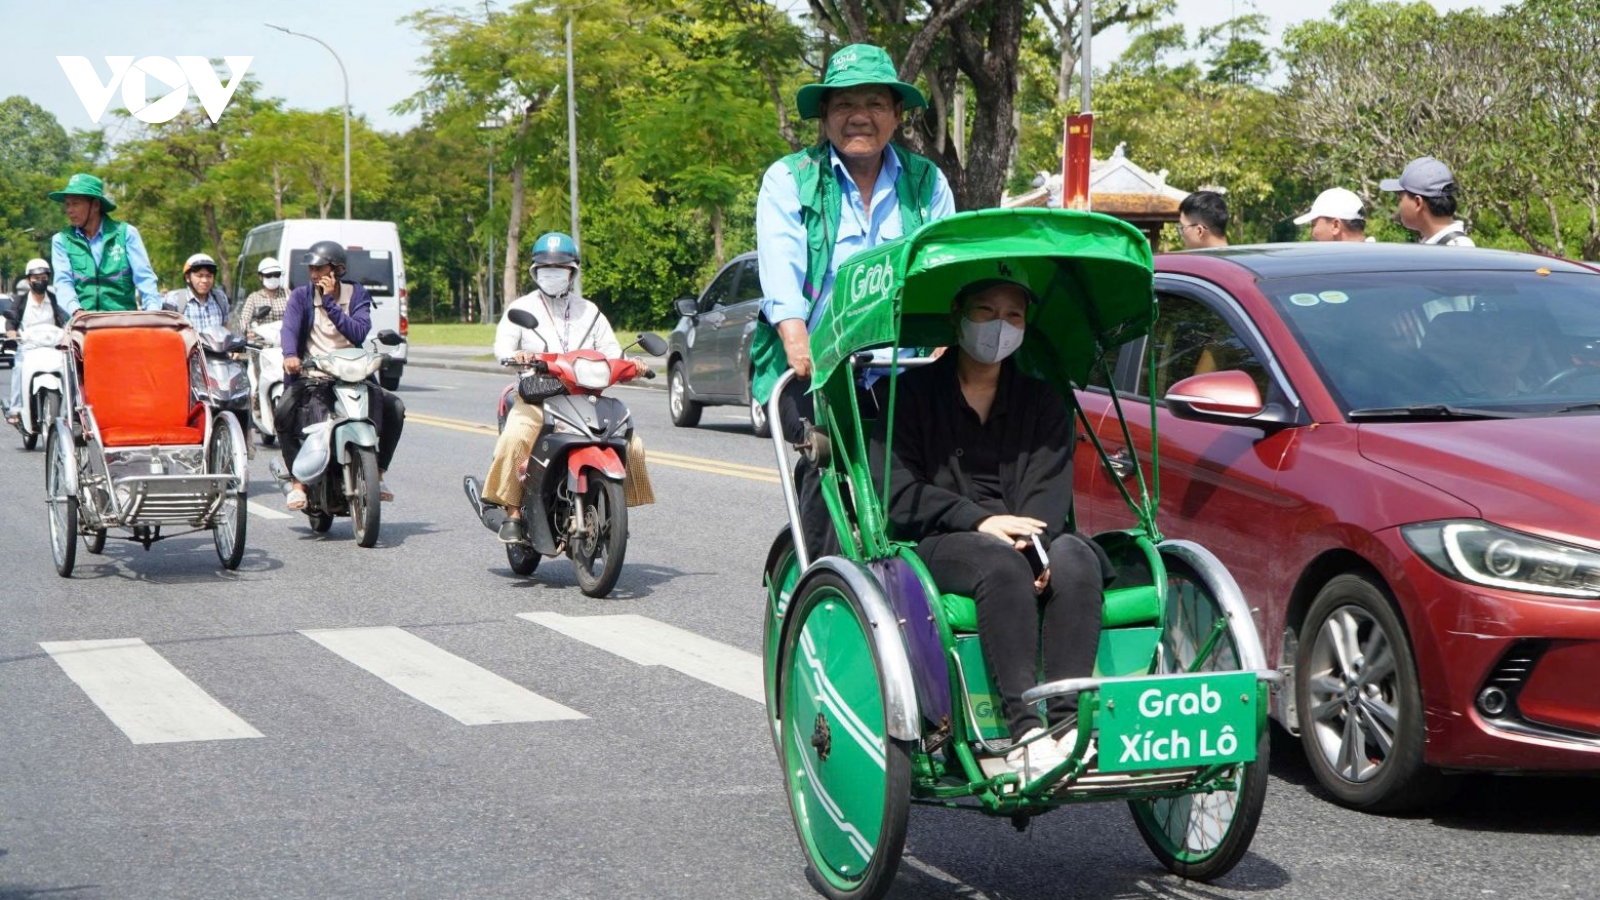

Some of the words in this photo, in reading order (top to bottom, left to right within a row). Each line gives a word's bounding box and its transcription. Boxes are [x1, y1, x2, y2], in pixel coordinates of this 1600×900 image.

[851, 254, 893, 303] Grab
[975, 702, 1007, 719] Gra
[1138, 683, 1222, 718] Grab
[1119, 729, 1191, 763] Xích
[1199, 724, 1238, 756] Lô
